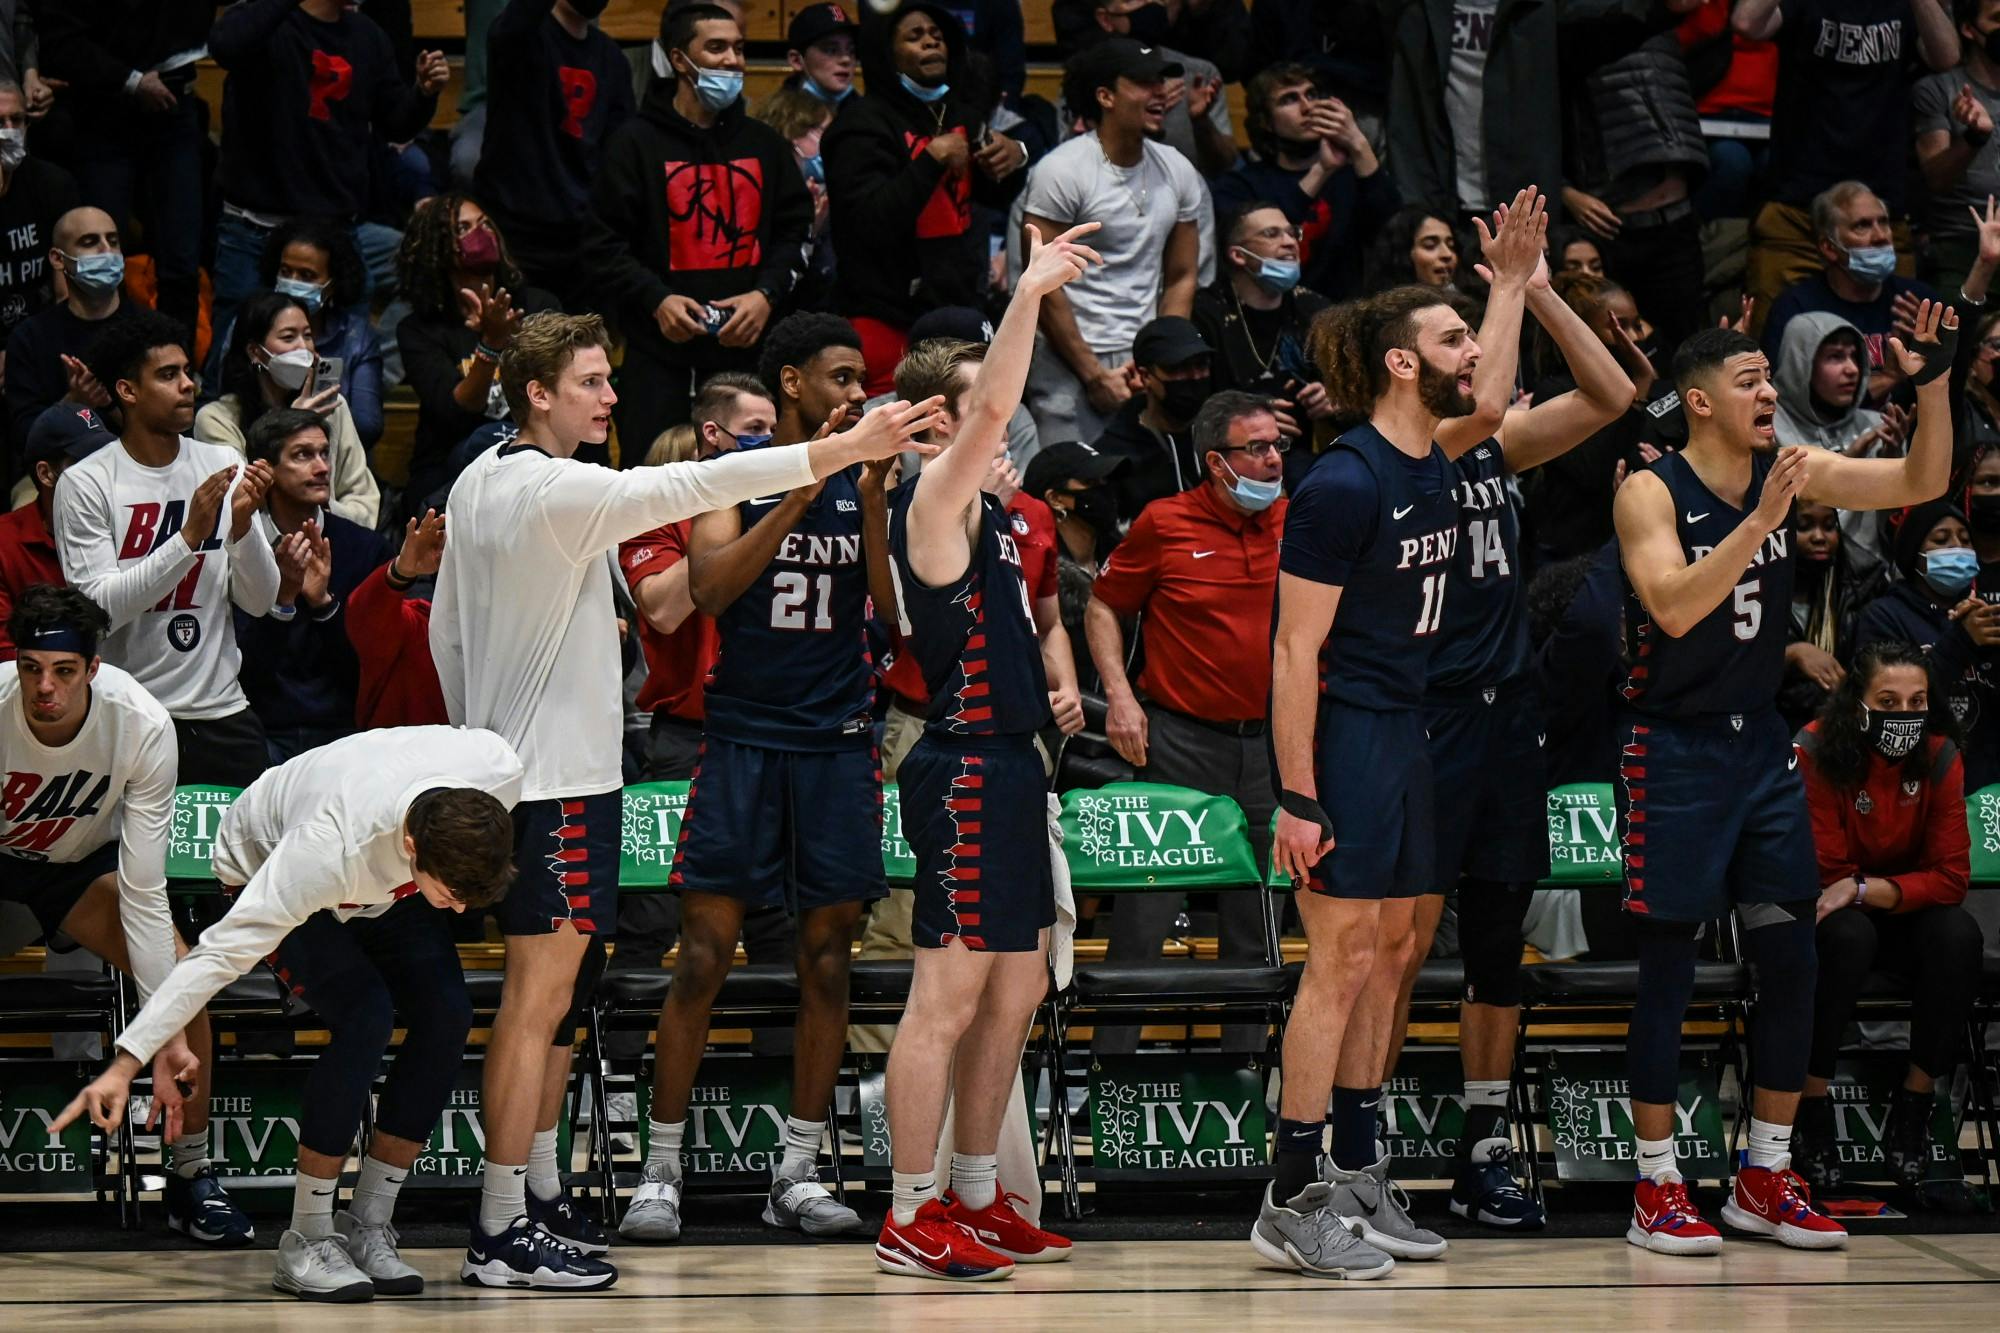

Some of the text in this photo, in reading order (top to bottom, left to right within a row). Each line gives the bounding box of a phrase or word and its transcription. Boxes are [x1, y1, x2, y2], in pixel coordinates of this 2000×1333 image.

[1813, 18, 1902, 65] PENN
[307, 49, 352, 122] P
[559, 65, 597, 140] P
[6, 223, 40, 252] THE
[21, 256, 45, 284] PIT
[1469, 519, 1510, 578] 14
[771, 571, 834, 629] 21
[1415, 572, 1446, 634] 11
[1733, 579, 1762, 640] 5
[183, 629, 190, 640] P
[2, 769, 111, 823] BALL
[193, 791, 231, 802] THE
[651, 794, 689, 806] THE
[1112, 797, 1149, 809] THE
[1562, 793, 1599, 805] THE
[1113, 809, 1208, 847] IVY
[1118, 848, 1217, 867] LEAGUE
[691, 1086, 730, 1101] THE
[1138, 1083, 1181, 1098] THE
[1827, 1086, 1869, 1100] THE
[209, 1097, 252, 1113] THE
[688, 1104, 788, 1148] IVY
[1139, 1100, 1251, 1146] IVY
[1143, 1148, 1256, 1169] LEAGUE
